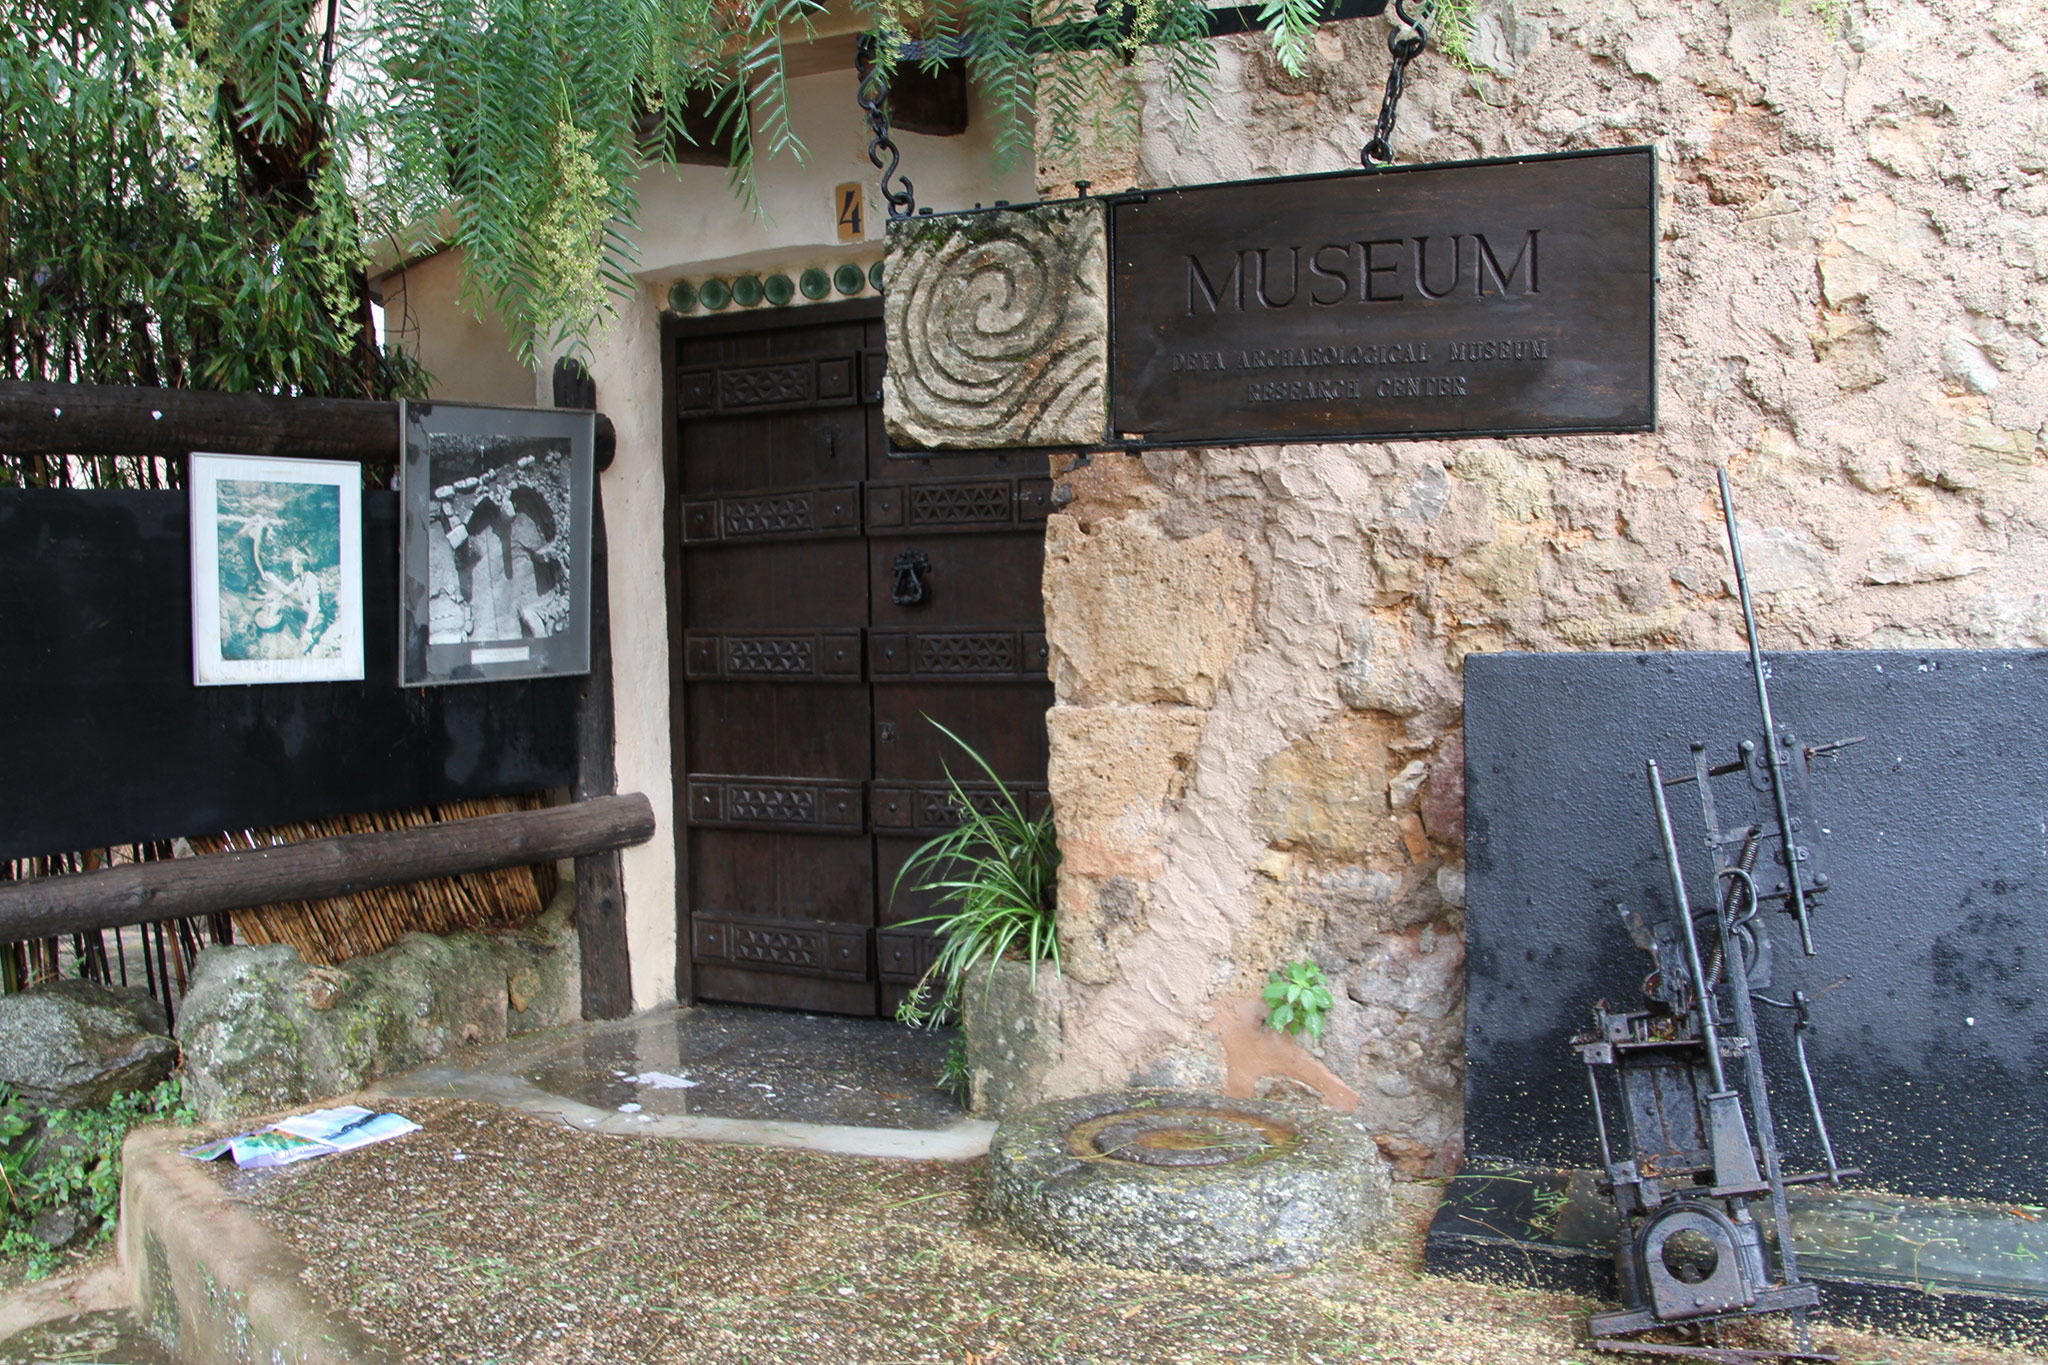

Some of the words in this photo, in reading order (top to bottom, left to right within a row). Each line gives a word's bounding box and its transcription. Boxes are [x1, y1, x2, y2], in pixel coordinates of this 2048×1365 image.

[840, 190, 862, 234] 4
[1184, 229, 1542, 317] MUSEUM
[1172, 351, 1226, 372] DEYA
[1238, 342, 1432, 369] ARCHAEOLOGICAL
[1449, 339, 1549, 364] MUSEUM
[1248, 378, 1361, 403] RESEARCH
[1376, 375, 1468, 399] CENTER
